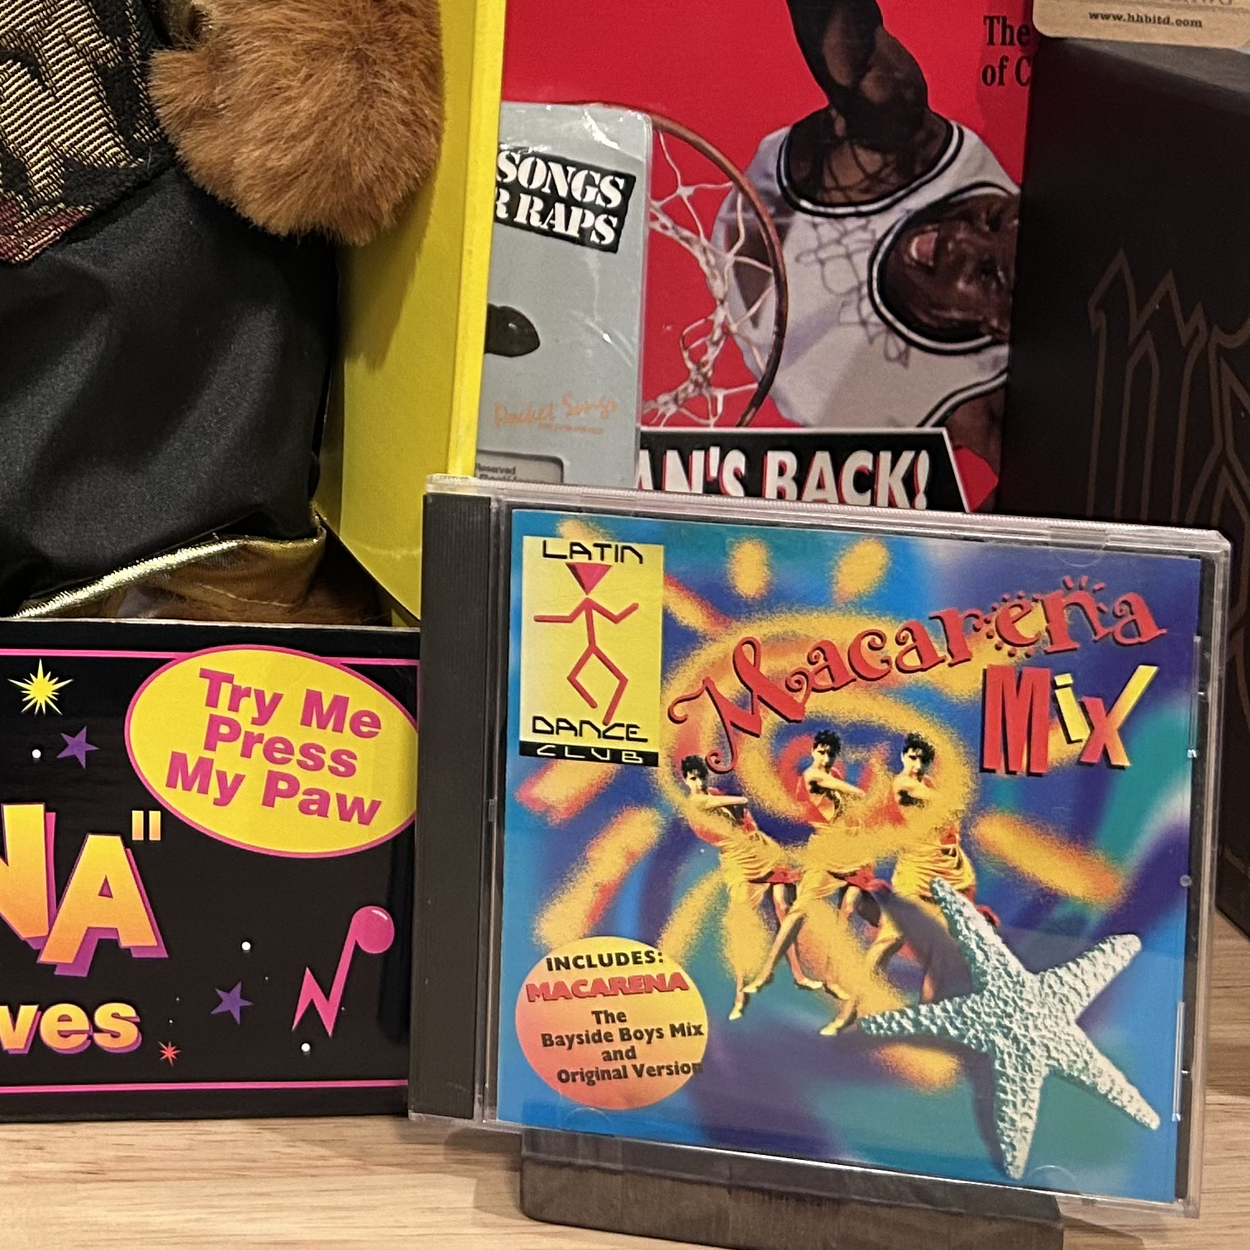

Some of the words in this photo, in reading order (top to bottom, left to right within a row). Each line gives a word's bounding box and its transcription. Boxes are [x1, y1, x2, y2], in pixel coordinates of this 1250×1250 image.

[983, 15, 1031, 47] The
[981, 57, 1008, 87] of
[497, 150, 624, 209] SONGS
[513, 192, 618, 246] RAPS
[763, 449, 929, 510] BACK!
[542, 539, 643, 565] LATIN
[666, 576, 1168, 772] Macarena
[198, 668, 284, 725] Try
[300, 688, 382, 740] Me
[531, 715, 649, 743] DANCE
[203, 714, 358, 779] Press
[536, 744, 644, 764] CLUB
[165, 750, 244, 808] My
[260, 776, 382, 827] Paw
[546, 950, 664, 971] INCLUDES:
[526, 972, 690, 1002] MACARENA
[591, 1010, 627, 1025] The
[541, 1029, 614, 1050] Bayside
[618, 1024, 664, 1045] Boys
[669, 1022, 705, 1038] Mix
[601, 1046, 637, 1062] and
[556, 1065, 628, 1086] Original
[631, 1061, 704, 1079] Version
